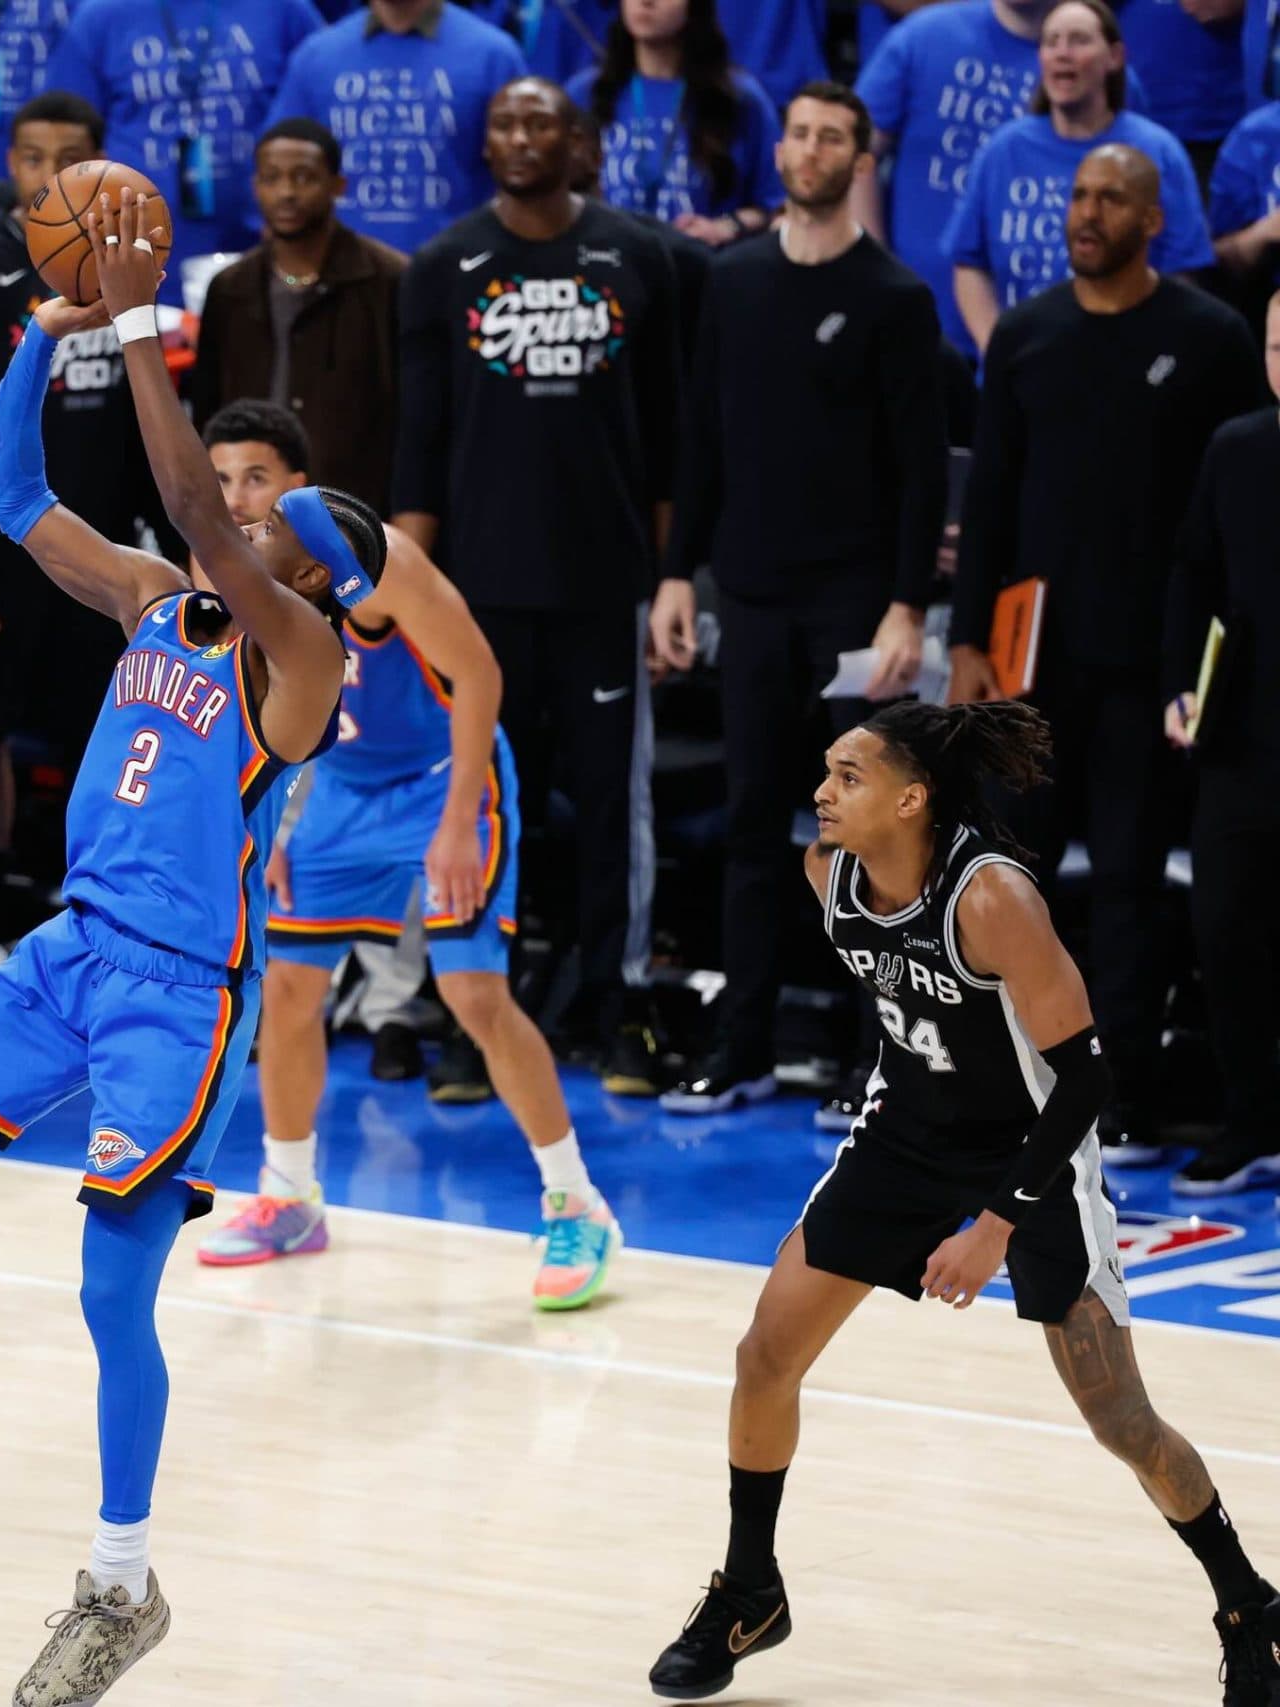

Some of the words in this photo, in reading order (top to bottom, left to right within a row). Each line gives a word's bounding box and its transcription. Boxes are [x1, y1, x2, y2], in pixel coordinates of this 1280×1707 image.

[341, 138, 445, 175] CITY
[522, 278, 578, 310] GO
[479, 290, 611, 365] Spurs
[65, 359, 111, 391] GO
[526, 344, 582, 377] GO
[115, 651, 230, 740] THUNDER
[115, 728, 160, 806] 2
[907, 936, 936, 951] LEDGER
[876, 997, 956, 1072] 24
